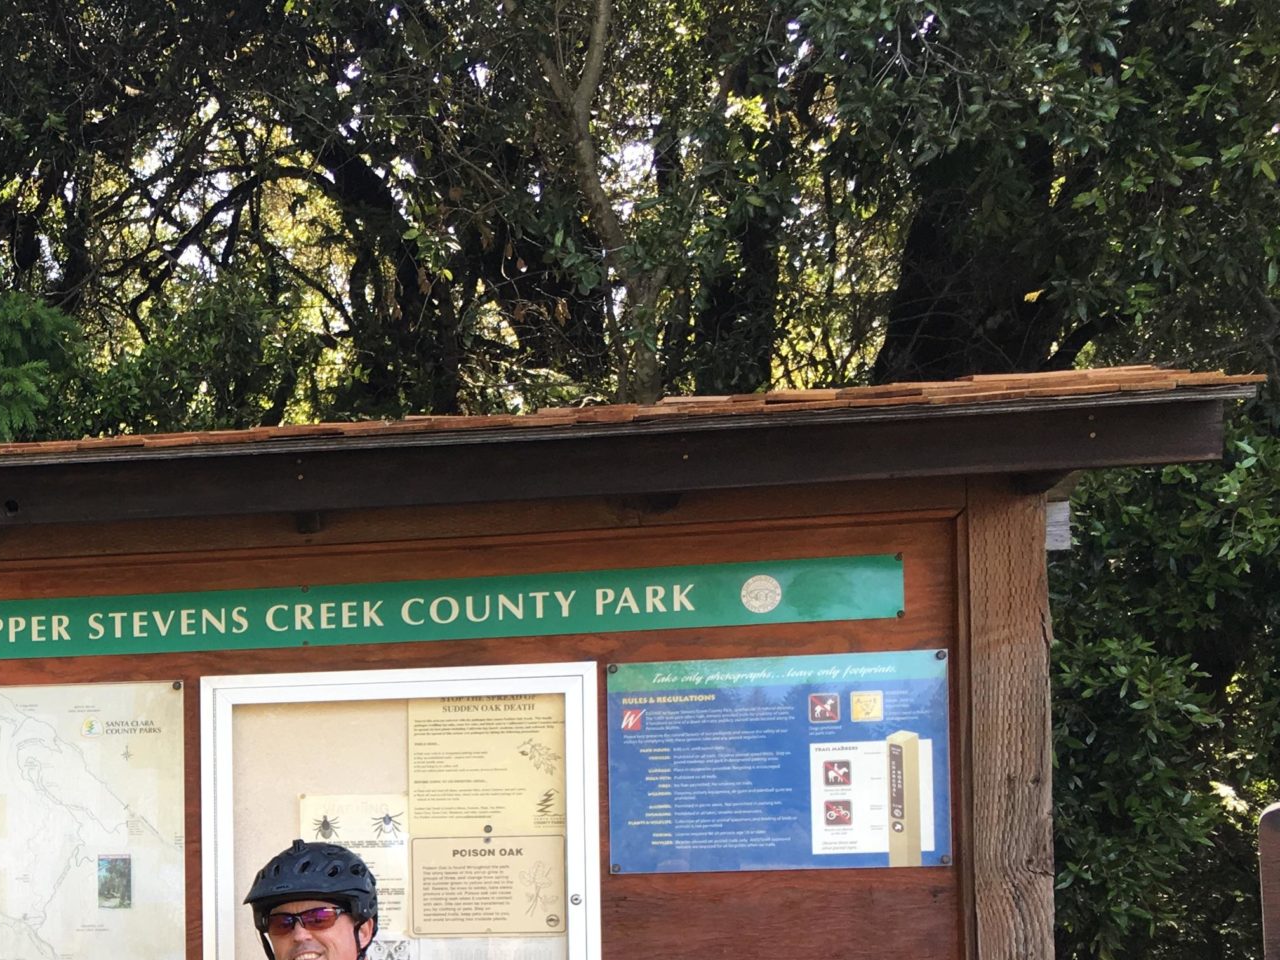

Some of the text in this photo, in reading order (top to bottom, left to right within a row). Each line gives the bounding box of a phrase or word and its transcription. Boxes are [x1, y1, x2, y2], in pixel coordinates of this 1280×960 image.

[87, 605, 250, 639] STEVENS
[265, 599, 386, 632] CREEK
[401, 590, 576, 625] COUNTY
[595, 583, 698, 614] PARK
[652, 672, 677, 684] Take
[681, 672, 704, 686] only
[816, 665, 840, 679] only
[622, 694, 716, 705] RULES & REGULATIONS
[442, 703, 536, 713] SUDDEN OAK DEATH
[452, 847, 524, 857] POISON OAK
